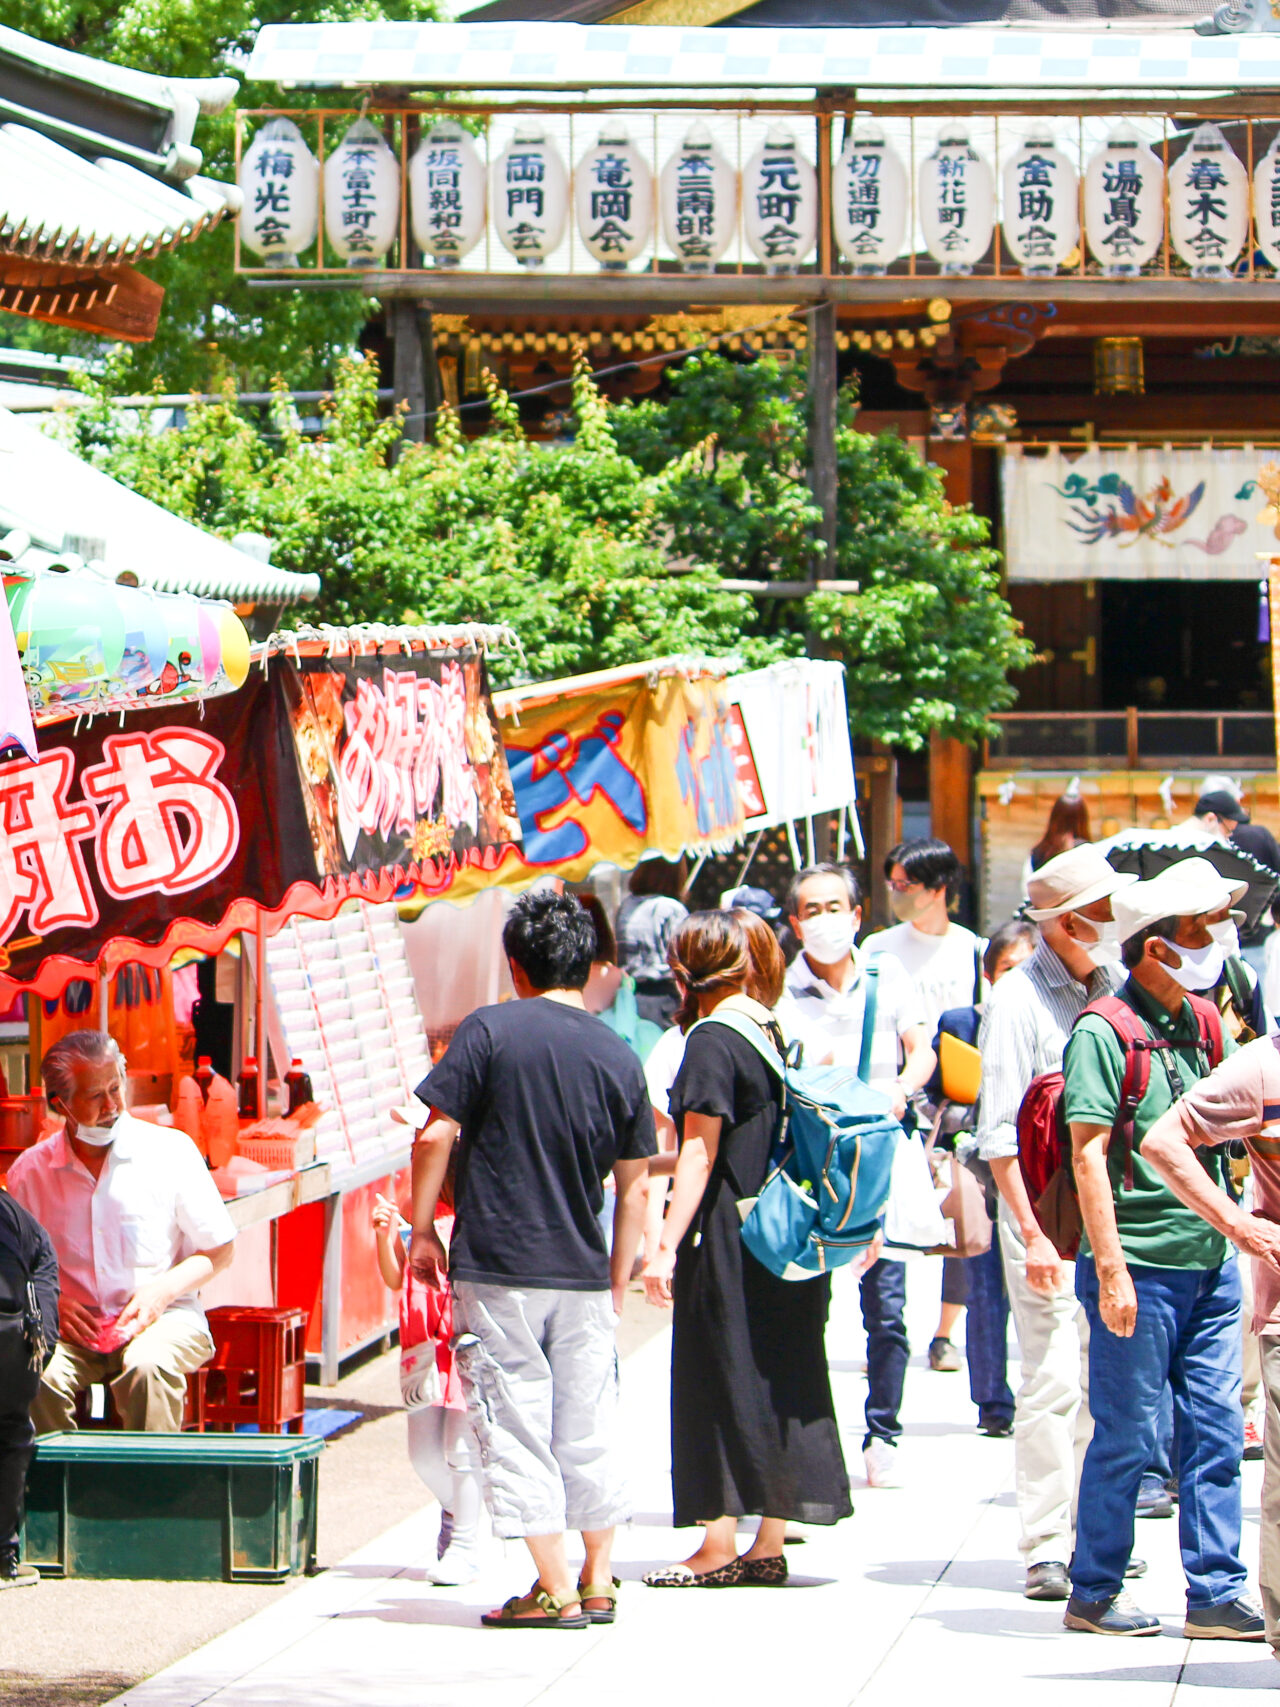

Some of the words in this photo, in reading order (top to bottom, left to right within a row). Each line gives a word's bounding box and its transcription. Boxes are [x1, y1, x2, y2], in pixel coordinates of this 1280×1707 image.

[254, 149, 295, 247] 梅光会
[341, 148, 377, 252] 本富士町会
[506, 152, 545, 250] 両門会
[589, 152, 634, 253] 竜岡会
[756, 156, 803, 258] 元町会
[846, 153, 884, 255] 切通町会
[937, 154, 970, 252] 新花町会
[1017, 153, 1057, 258] 金助会
[1184, 157, 1231, 259] 春木会
